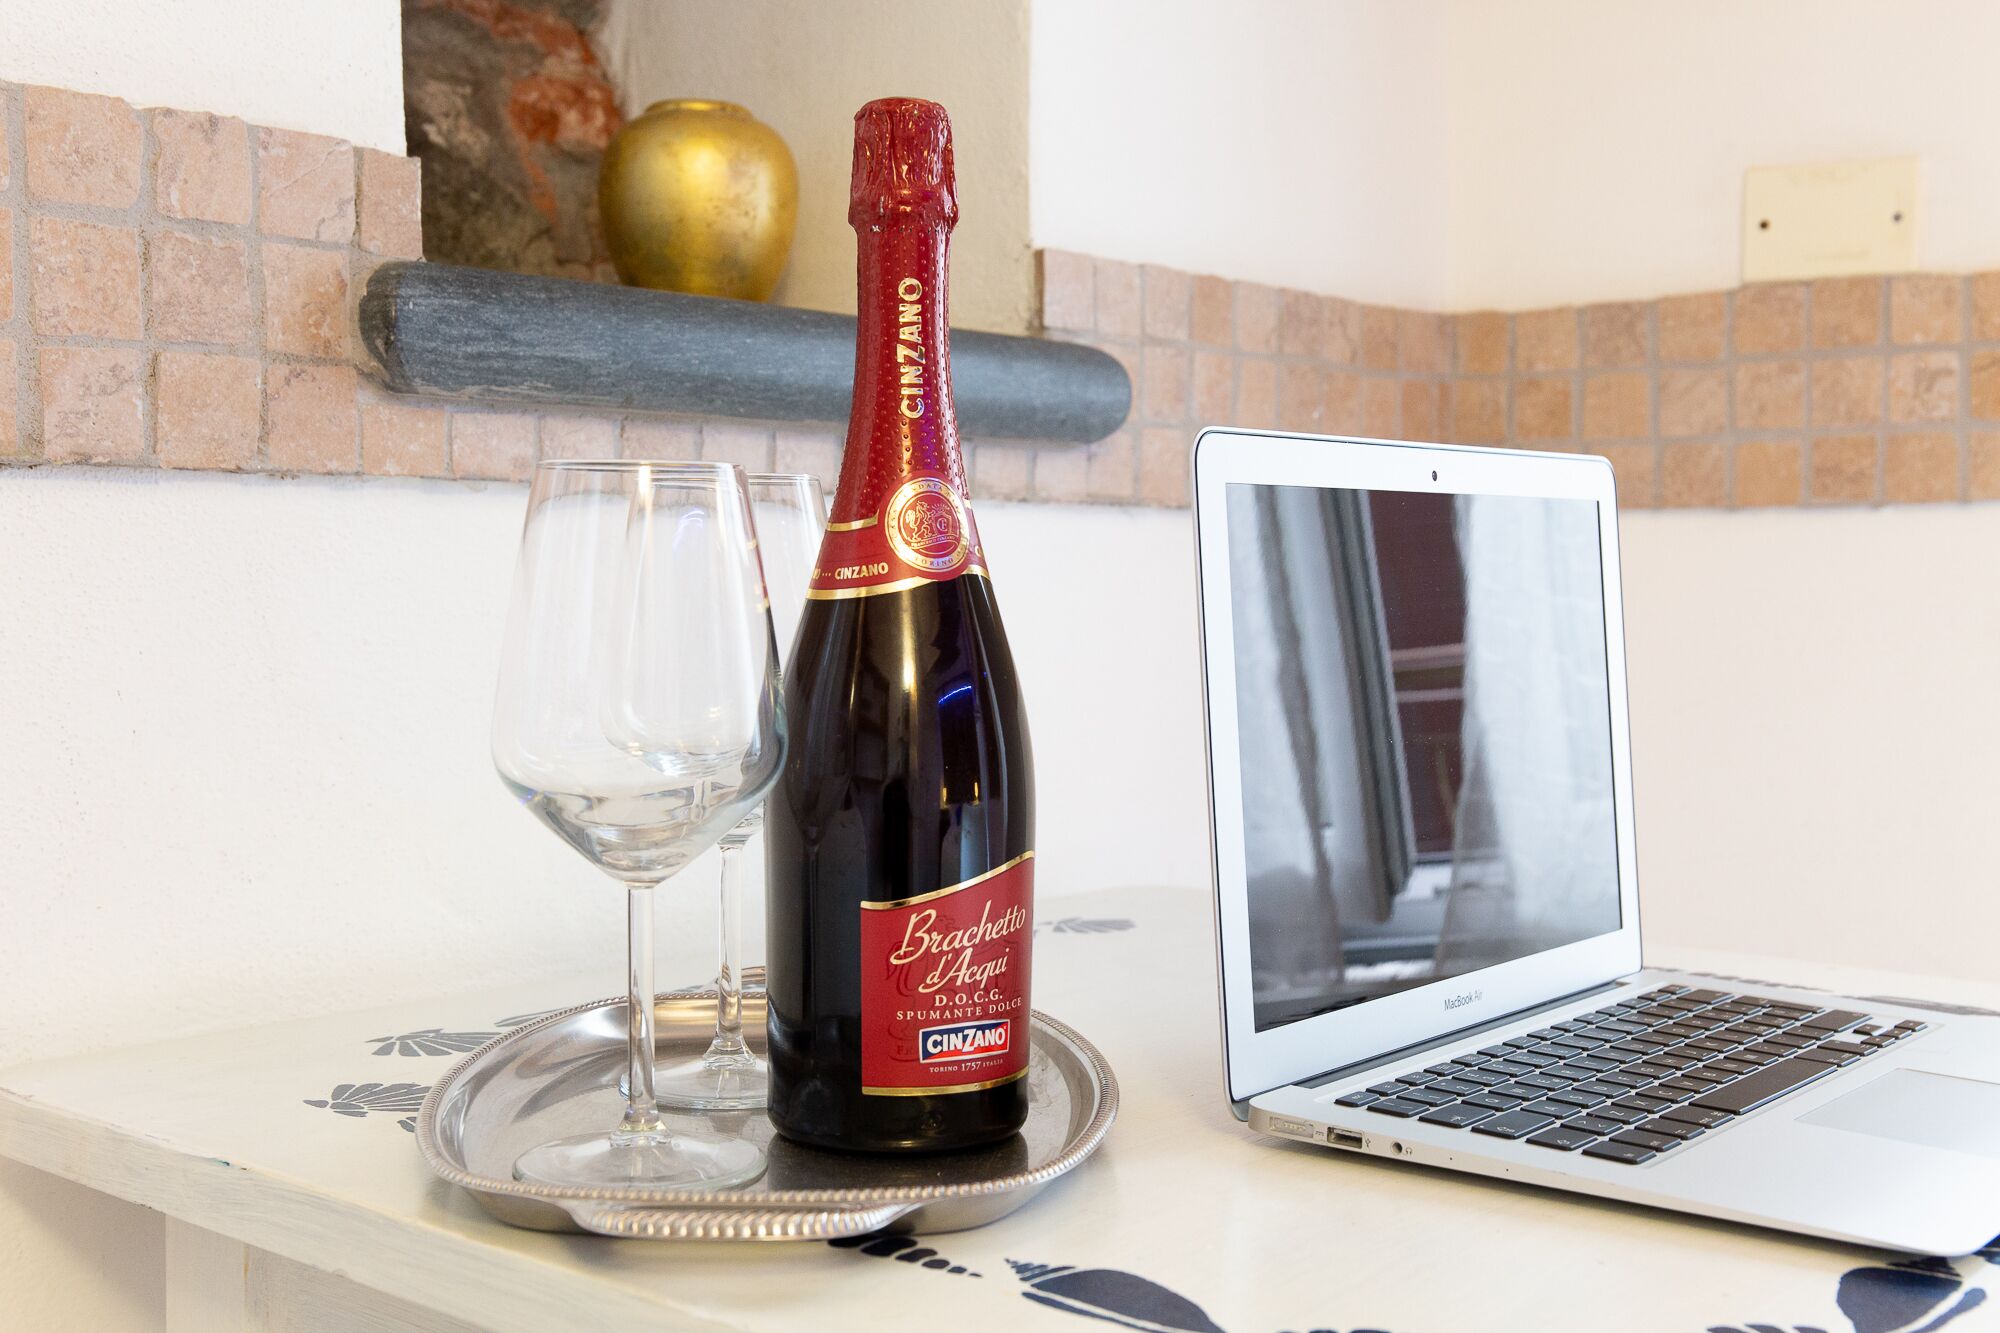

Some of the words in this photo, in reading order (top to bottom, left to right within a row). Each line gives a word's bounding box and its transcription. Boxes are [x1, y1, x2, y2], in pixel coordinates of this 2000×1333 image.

[897, 277, 926, 419] CINZANO
[834, 562, 889, 580] CINZANO
[890, 900, 1026, 965] Brachetto
[918, 947, 1010, 993] d'Acqui
[896, 1006, 983, 1020] SPUMANTE
[988, 996, 1022, 1014] DOLCE
[934, 988, 1003, 1007] D.O.C.G.
[1444, 992, 1474, 1011] MacBook
[926, 1027, 1006, 1054] CINZANO
[929, 1065, 958, 1073] TORINO
[960, 1061, 982, 1072] 1757
[982, 1058, 1004, 1068] ITALIA
